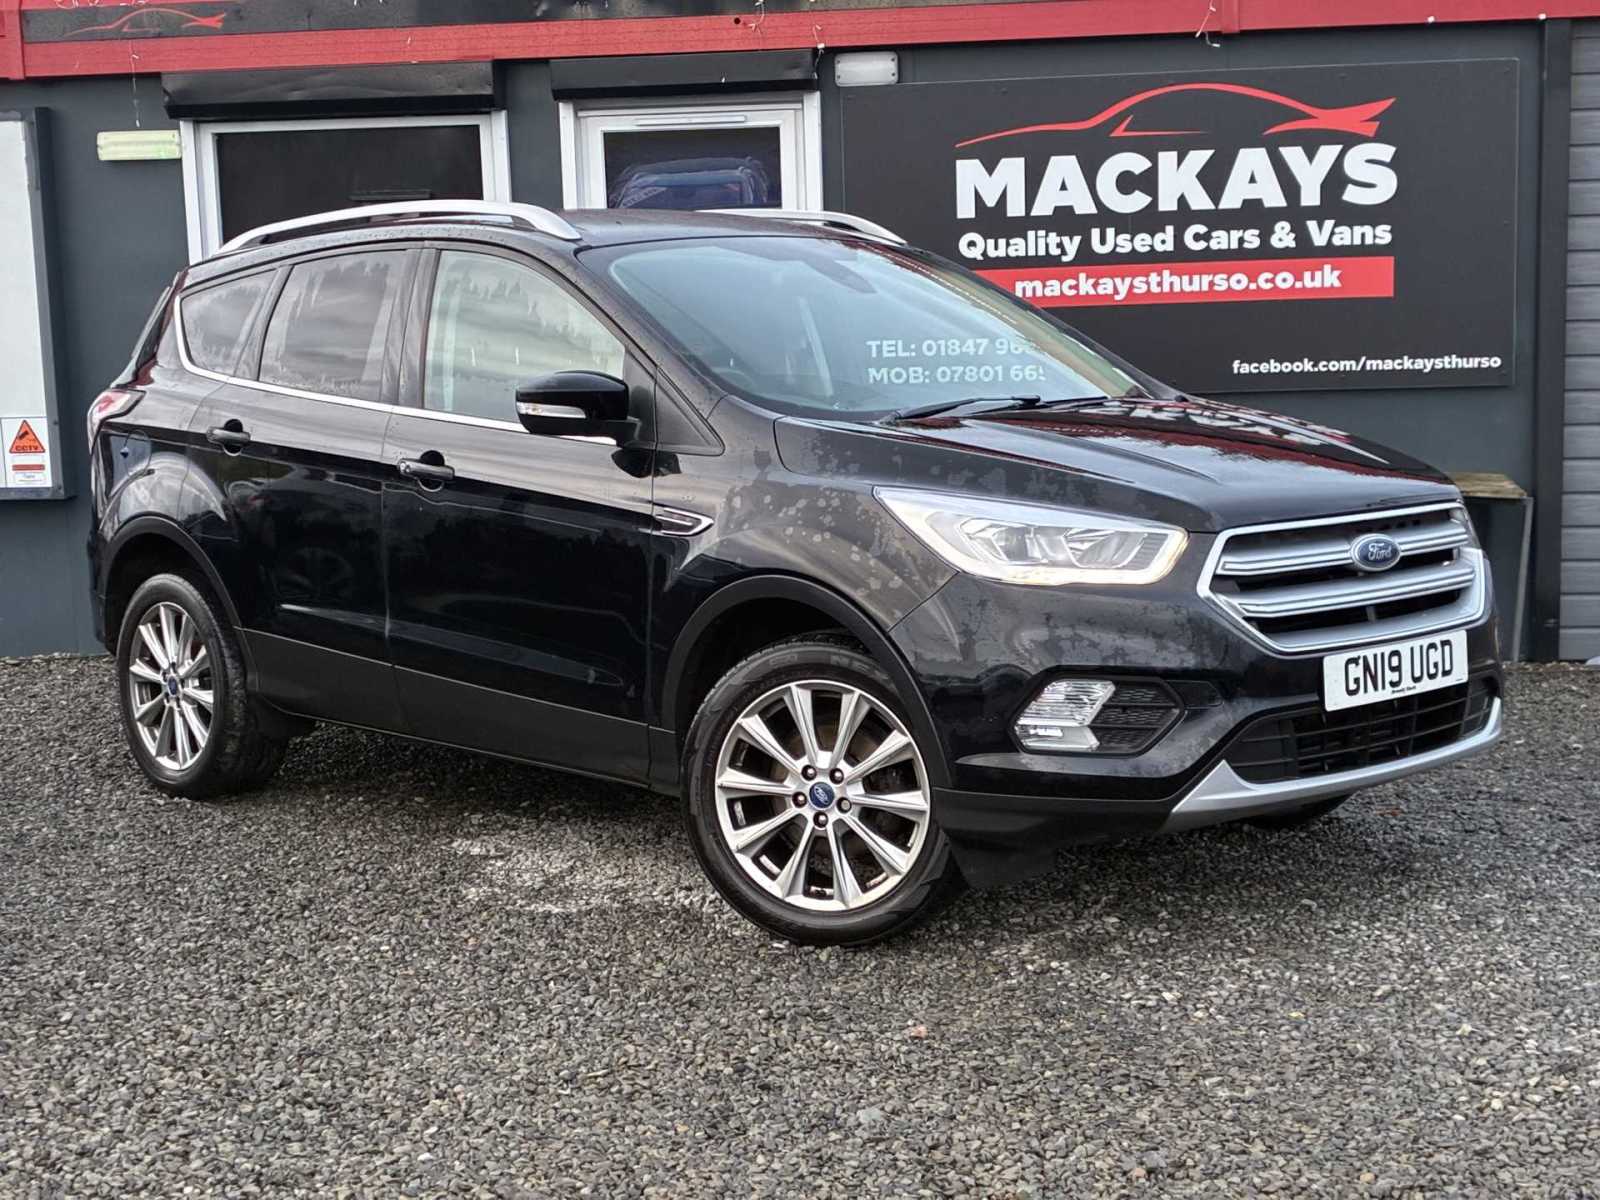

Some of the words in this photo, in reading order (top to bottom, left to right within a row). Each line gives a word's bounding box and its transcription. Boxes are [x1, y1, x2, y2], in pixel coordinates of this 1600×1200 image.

[954, 142, 1398, 220] MACKAYS
[958, 230, 1082, 262] Quality
[1091, 225, 1175, 254] Used
[1183, 224, 1261, 250] Cars
[1270, 221, 1296, 248] &
[1306, 219, 1392, 246] Vans
[1014, 264, 1343, 300] mackaysthurso.co.uk
[866, 339, 916, 358] TEL:
[922, 338, 989, 356] 01847
[867, 366, 930, 384] MOB:
[935, 365, 1004, 383] 07801
[1232, 354, 1502, 374] facebook.com/mackaysthurso
[1368, 542, 1392, 560] Ford
[1344, 649, 1403, 697] GN19
[1410, 639, 1454, 684] UGD
